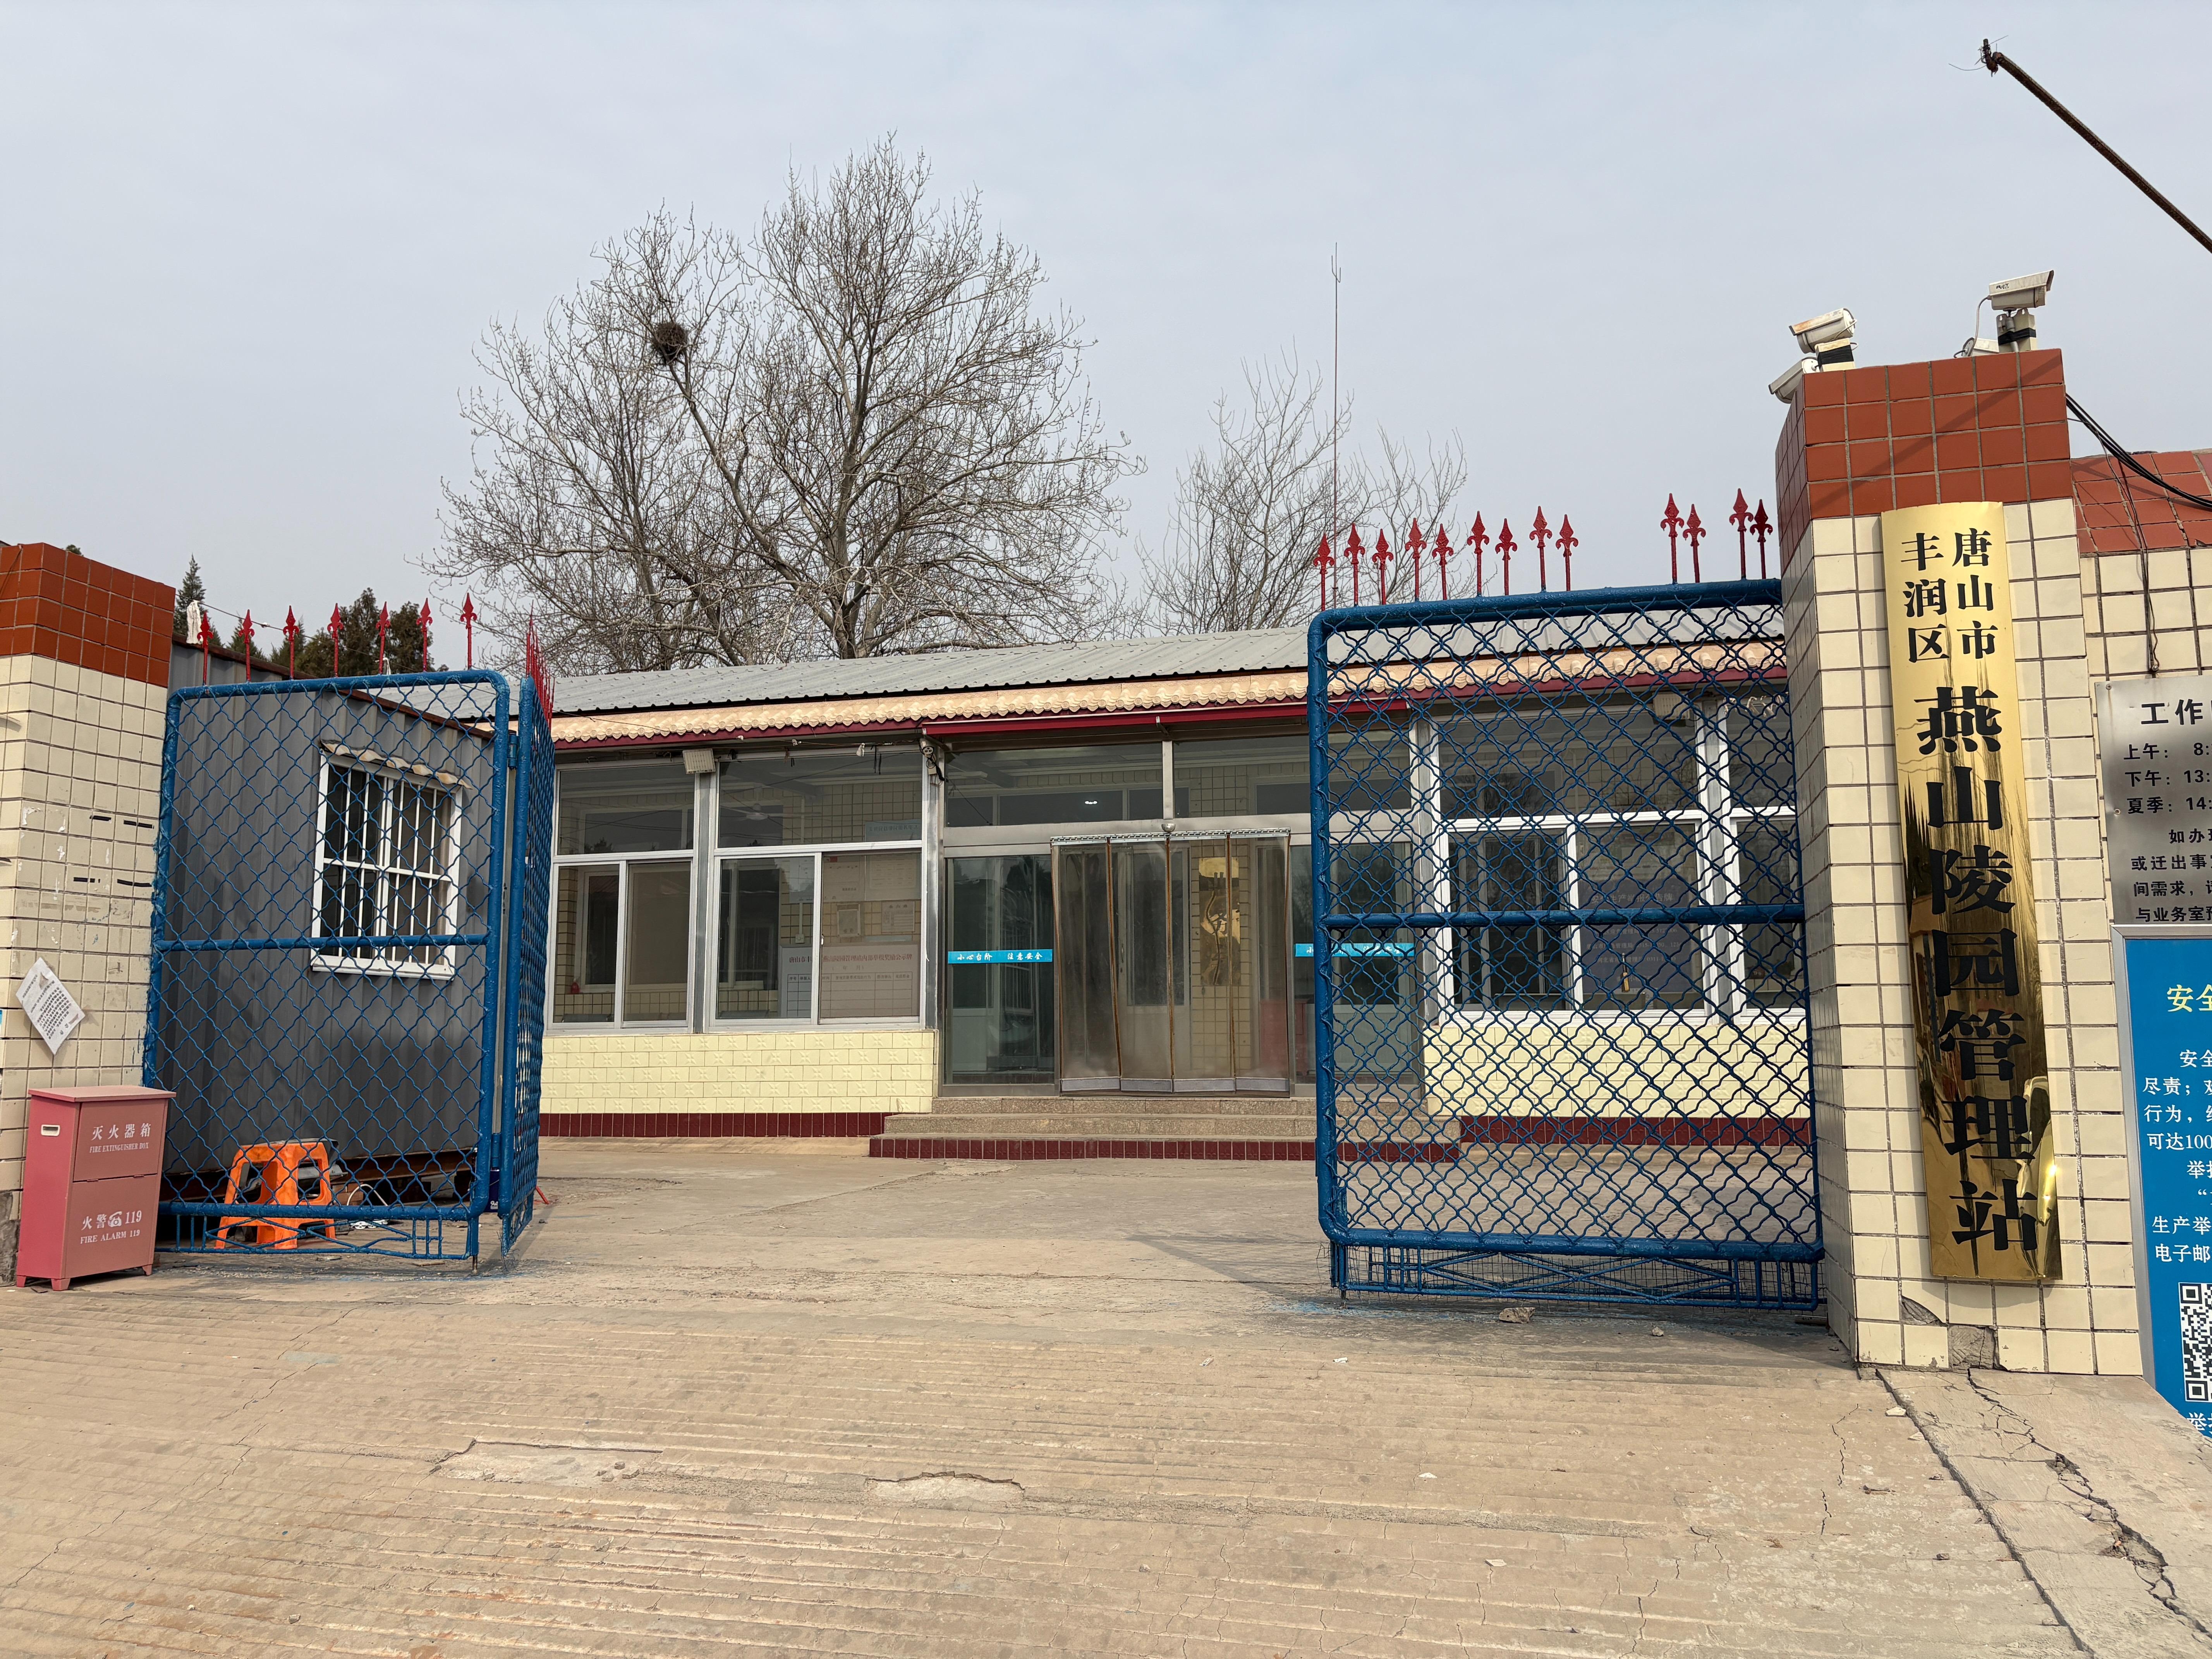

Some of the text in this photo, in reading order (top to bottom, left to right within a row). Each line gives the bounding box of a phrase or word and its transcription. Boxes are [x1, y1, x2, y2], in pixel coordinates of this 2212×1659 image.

[1901, 532, 1949, 663] 丰润区
[1952, 527, 1998, 659] 唐山市
[2141, 698, 2212, 725] 工作
[2123, 742, 2212, 760] 上午： 8:
[2125, 770, 2171, 787] 下午：
[2127, 796, 2173, 814] 夏季：
[2169, 828, 2212, 843] 如办
[2131, 854, 2212, 871] 或迁出事
[957, 952, 993, 961] 小心台阶
[1007, 951, 1043, 961] 注意安全
[1913, 685, 2038, 1251] 燕山陵园管理站
[2166, 984, 2212, 1013] 安全
[2179, 1049, 2212, 1067] 安全
[91, 1123, 151, 1140] 灭火器箱
[89, 1145, 101, 1154] FIRE
[102, 1143, 138, 1152] EXTINGUISHER
[81, 1210, 142, 1230] 火警 119
[80, 1234, 98, 1244] FIRE
[100, 1231, 127, 1241] ALARM
[2155, 1243, 2212, 1263] 电子邮
